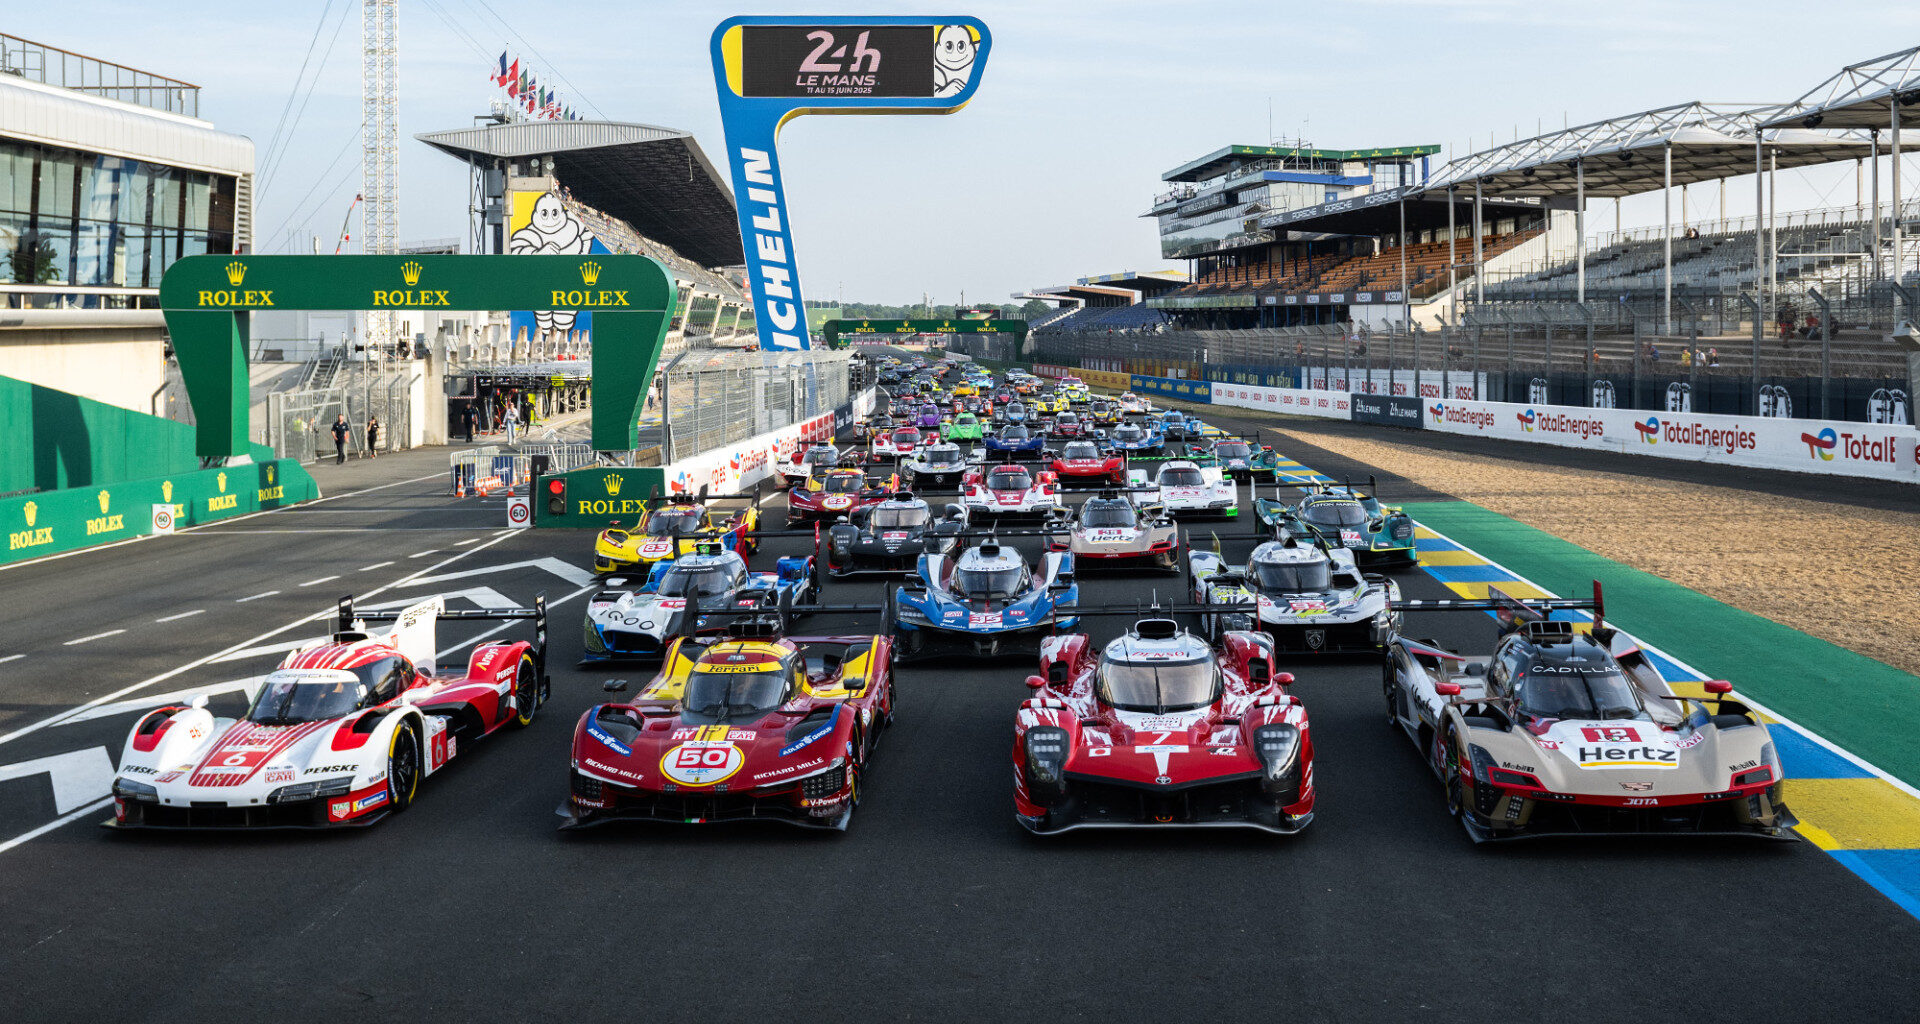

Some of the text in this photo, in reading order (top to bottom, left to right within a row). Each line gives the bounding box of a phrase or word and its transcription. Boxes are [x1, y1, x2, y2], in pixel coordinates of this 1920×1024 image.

[796, 75, 876, 86] LE MANS
[1364, 191, 1398, 204] PORSCHE
[1292, 208, 1317, 220] PORSCHE
[1324, 201, 1352, 213] PORSCHE
[1261, 215, 1283, 226] PORSCHE
[741, 147, 806, 351] ICHELIN
[198, 290, 274, 307] ROLEX
[373, 290, 450, 307] ROLEX
[551, 290, 630, 307] ROLEX
[1361, 381, 1377, 394] BOCH
[1389, 382, 1407, 396] OSCH
[1420, 383, 1440, 398] BOSCH
[1336, 400, 1350, 410] BOSCH
[1444, 405, 1495, 429] TotalEnergies
[1536, 412, 1604, 440] TotalEnergies
[1661, 420, 1756, 454] TotalEnergies
[258, 485, 285, 503] ROLEX
[208, 494, 237, 512] ROLEX
[578, 500, 648, 514] ROLEX
[158, 515, 169, 524] 60
[512, 509, 526, 517] 60
[86, 514, 125, 536] ROLEX
[9, 527, 54, 550] ROLEX
[643, 544, 668, 552] 83
[496, 664, 516, 681] PENSKE
[708, 664, 760, 672] Ferrari
[1532, 665, 1622, 673] CADILLAC
[587, 728, 605, 741] ADLER
[671, 731, 694, 740] HY
[782, 726, 832, 755] ADLER GROUP
[1151, 731, 1172, 745] 7
[435, 734, 444, 764] 6
[1579, 747, 1677, 762] Hertz
[222, 751, 248, 766] 6
[678, 749, 727, 766] 50
[123, 765, 160, 775] PENSKE
[303, 764, 359, 775] PENSKE
[585, 758, 644, 780] RICHARD MILLE
[753, 757, 824, 780] RICHARD MILLE
[1503, 762, 1527, 772] Mobil
[1729, 762, 1749, 773] Mobil
[578, 798, 604, 807] V-Power
[810, 797, 840, 807] V-Power
[1623, 798, 1659, 806] JOTA
